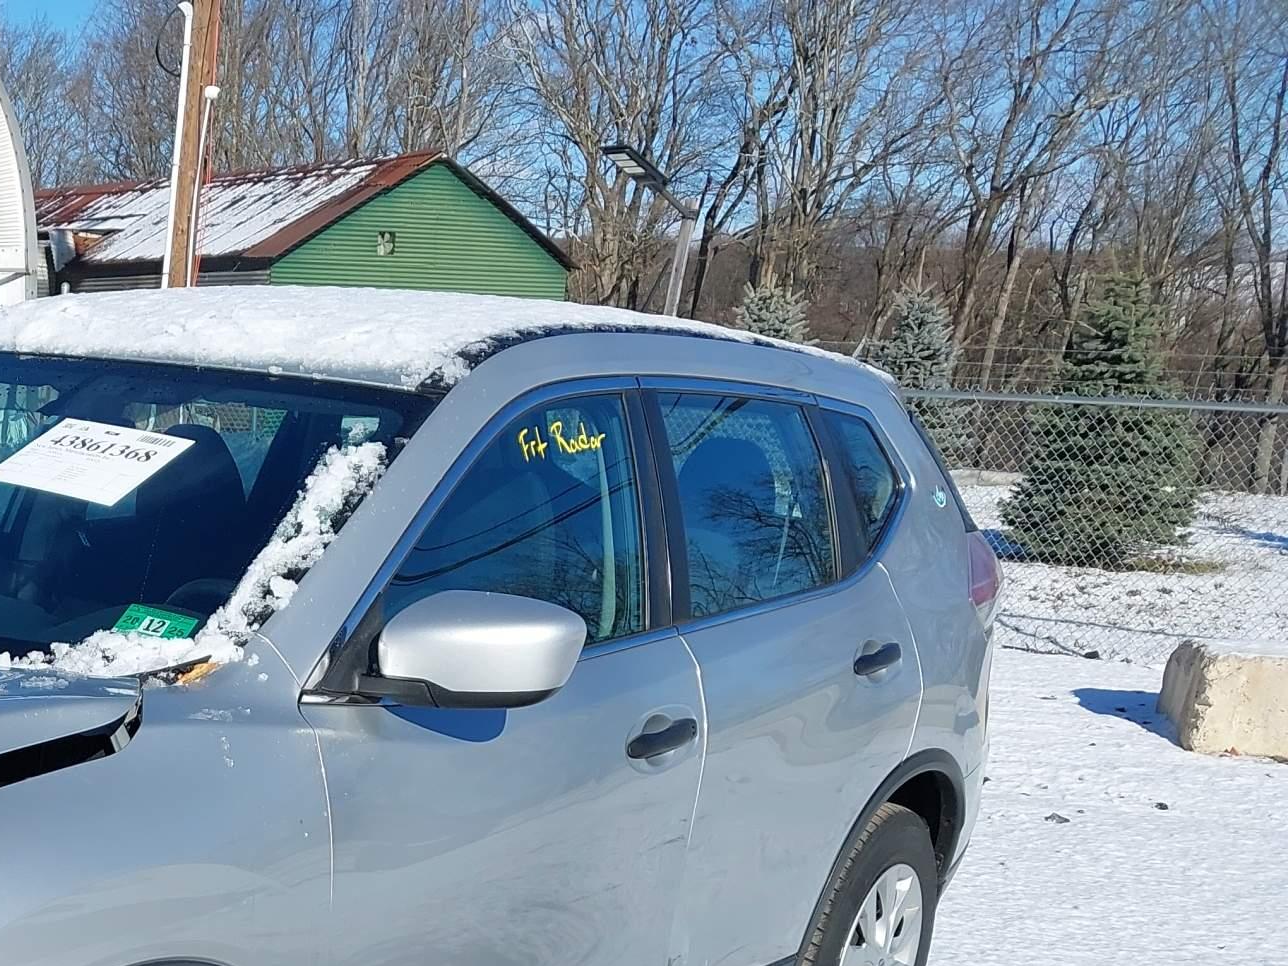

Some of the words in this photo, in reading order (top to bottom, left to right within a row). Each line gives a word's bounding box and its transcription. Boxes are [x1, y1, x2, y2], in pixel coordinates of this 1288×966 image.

[49, 433, 158, 463] 43861368
[550, 421, 605, 454] Radar
[142, 618, 167, 633] 12
[168, 627, 184, 637] 25
